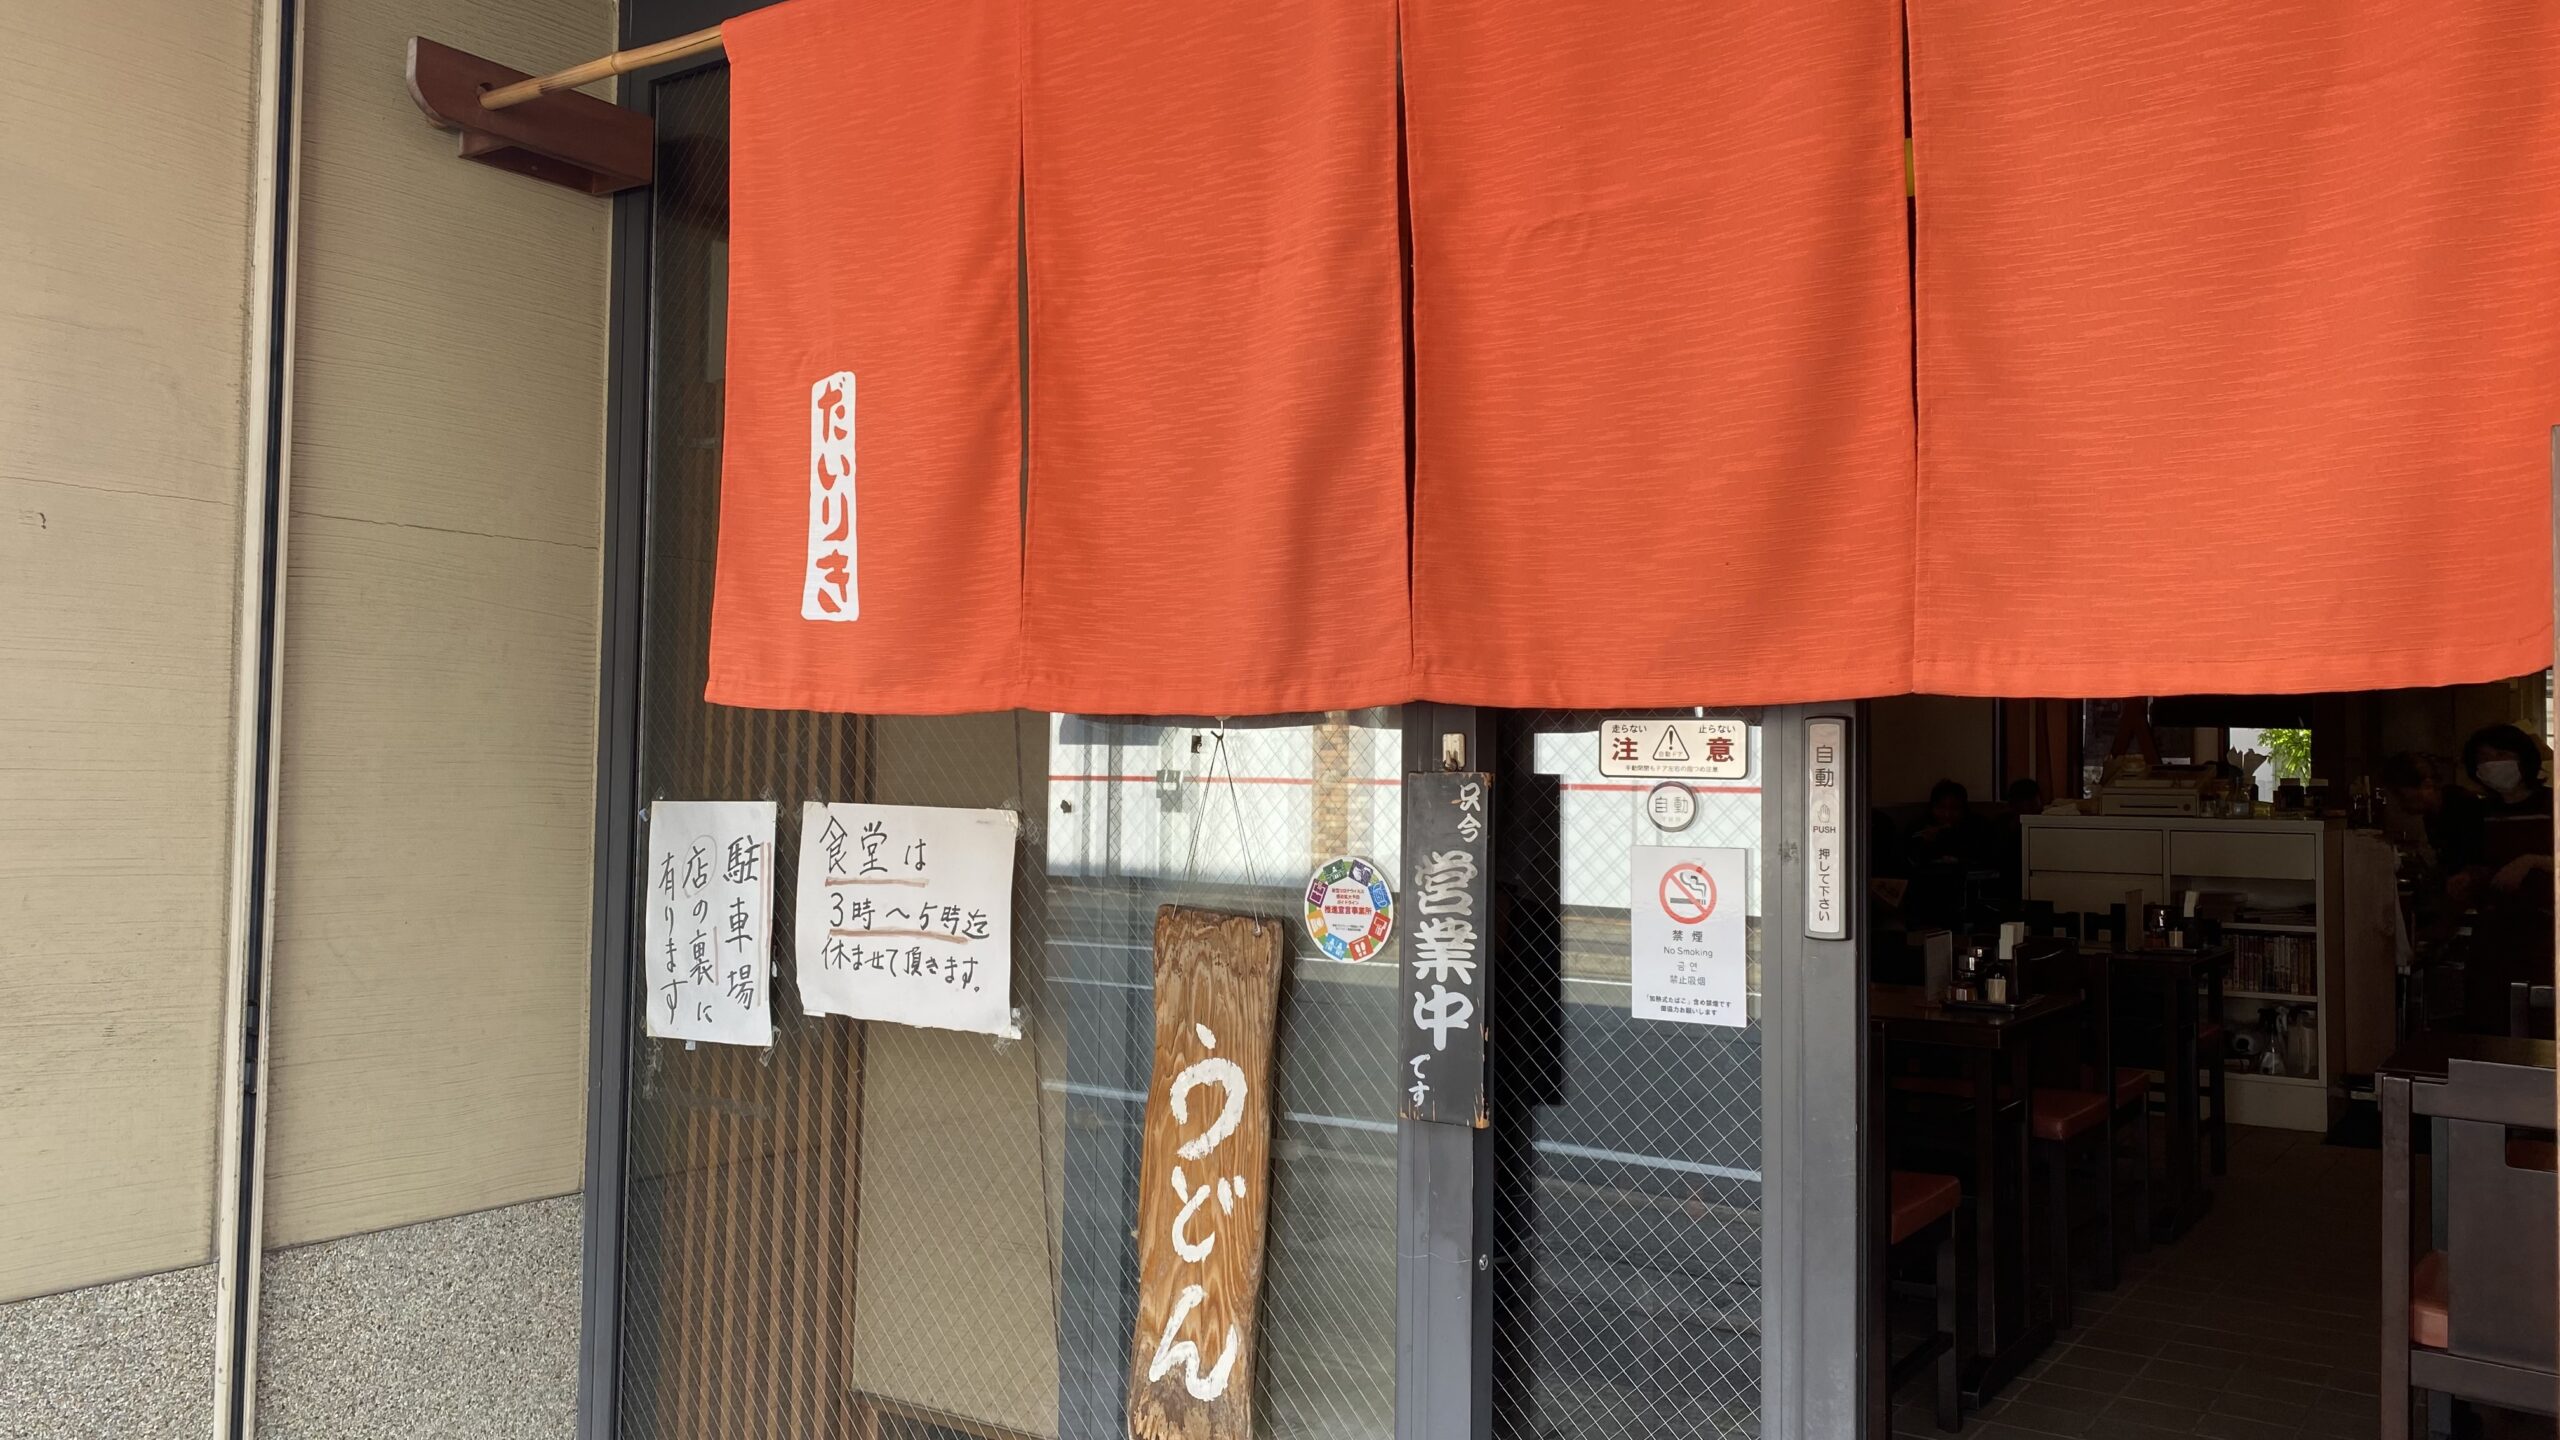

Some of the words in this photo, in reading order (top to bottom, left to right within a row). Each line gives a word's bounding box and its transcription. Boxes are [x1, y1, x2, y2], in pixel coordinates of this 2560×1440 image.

[816, 376, 851, 614] だいりき
[1611, 724, 1647, 733] 走らない
[1699, 724, 1736, 733] 止らない
[1815, 744, 1834, 788] 自動
[1655, 797, 1689, 814] 自動
[1812, 826, 1836, 834] PUSH
[819, 815, 927, 875] 食堂は
[1818, 848, 1830, 922] 押して下さい
[658, 852, 688, 1025] 有ります
[682, 845, 717, 1024] 店の裏に
[723, 834, 762, 1012] 駐車場
[1412, 850, 1479, 1051] 営業中
[1663, 946, 1676, 955] No
[1677, 947, 1713, 958] Smoking
[821, 937, 982, 993] 休ませて頂きます。
[1148, 1022, 1246, 1401] うどん
